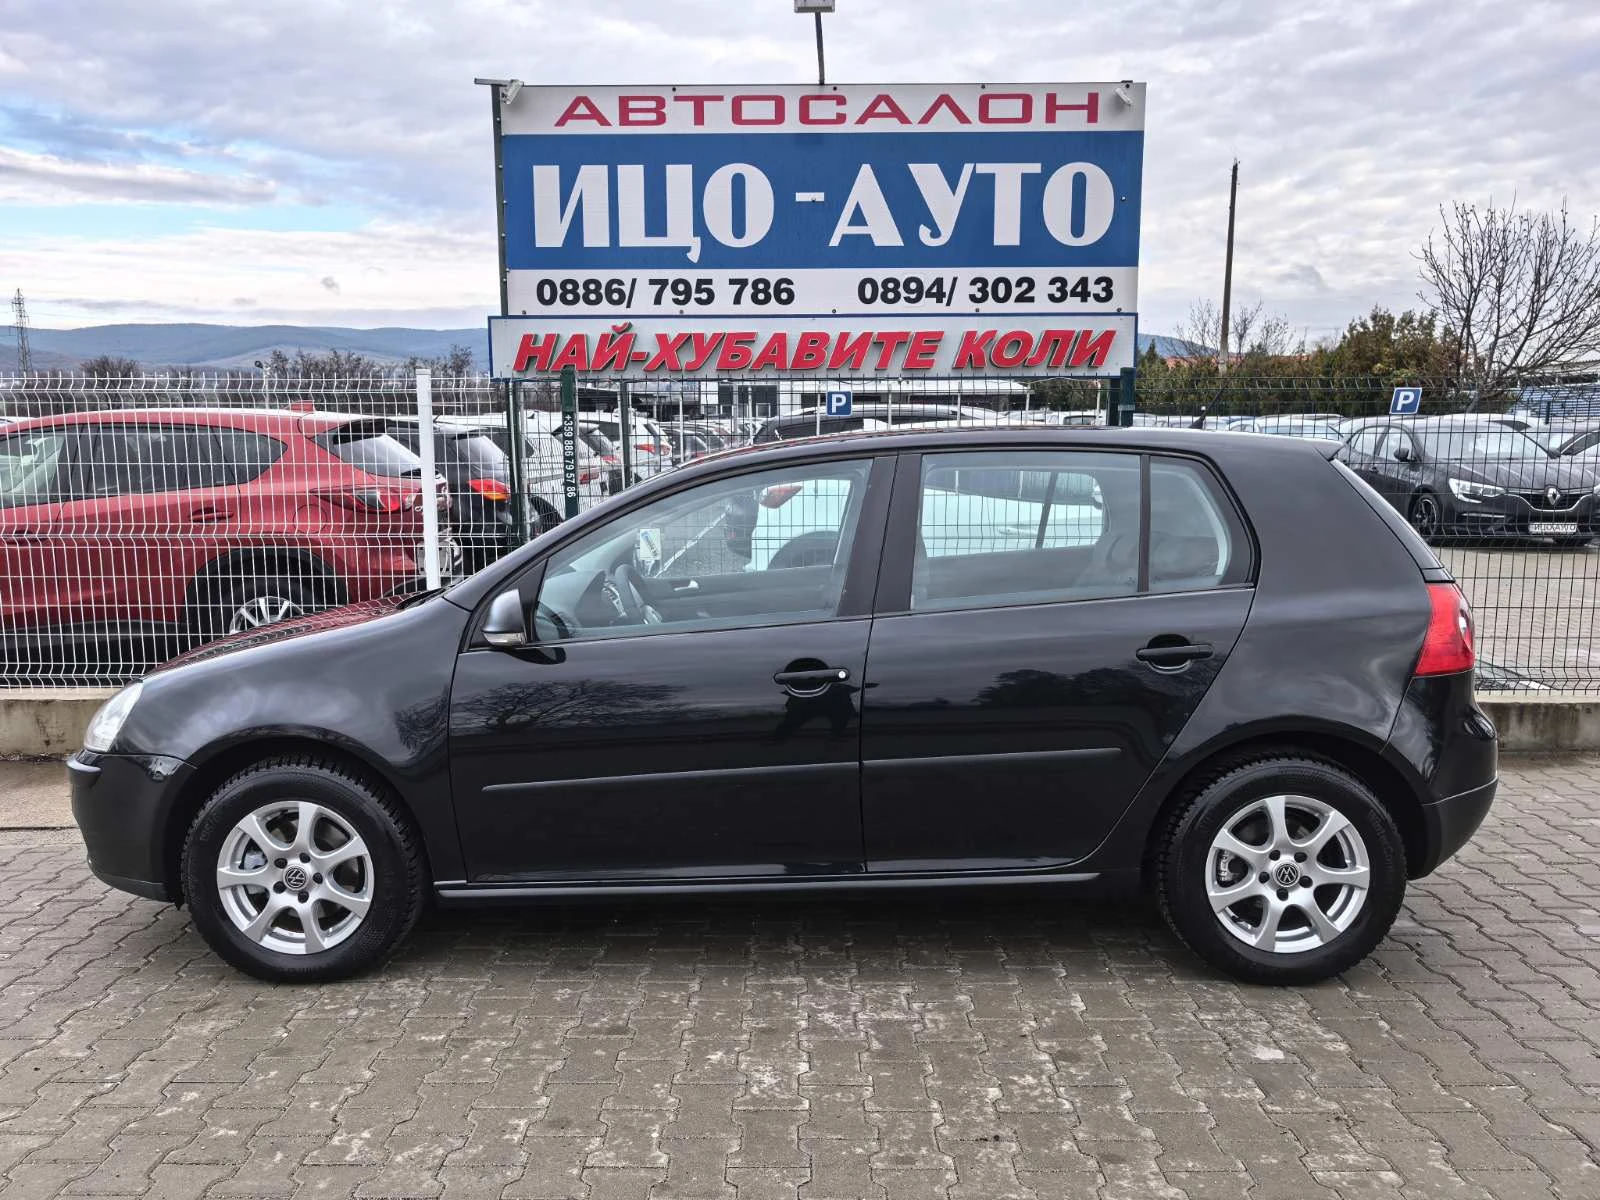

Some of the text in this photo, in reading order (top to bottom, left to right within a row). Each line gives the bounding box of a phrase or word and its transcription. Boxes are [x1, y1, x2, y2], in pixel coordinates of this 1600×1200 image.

[554, 92, 1099, 127] АВТОСАЛОН
[536, 278, 795, 308] 0886/ 795 786
[857, 276, 1114, 306] 0894/ 302 343
[512, 320, 1117, 372] НАЙ-ХУБАВИТЕ КОЛИ
[830, 393, 848, 413] P
[1395, 391, 1416, 411] P
[563, 415, 577, 498] +359 886 79 57 86
